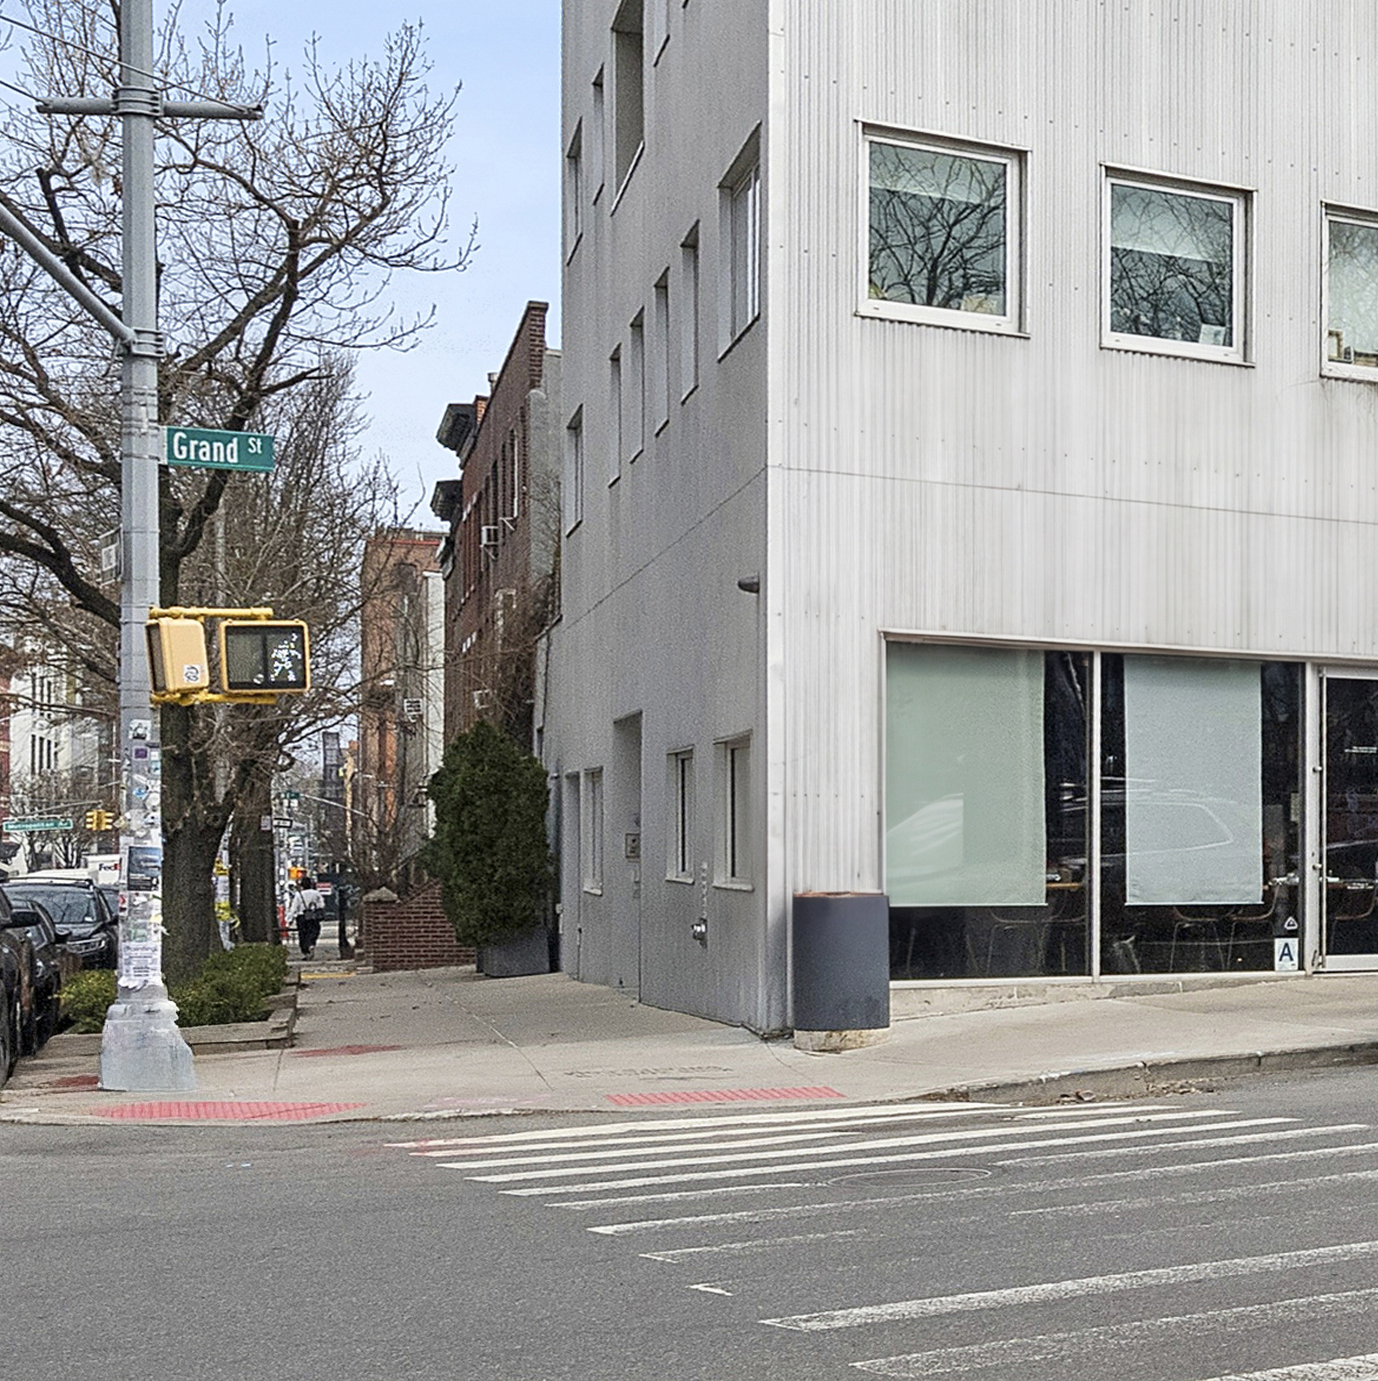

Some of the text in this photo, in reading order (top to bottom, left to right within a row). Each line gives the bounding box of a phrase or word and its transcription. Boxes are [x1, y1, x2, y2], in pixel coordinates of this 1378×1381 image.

[173, 431, 262, 463] Grand St
[99, 863, 121, 871] FedE
[1279, 942, 1294, 961] A
